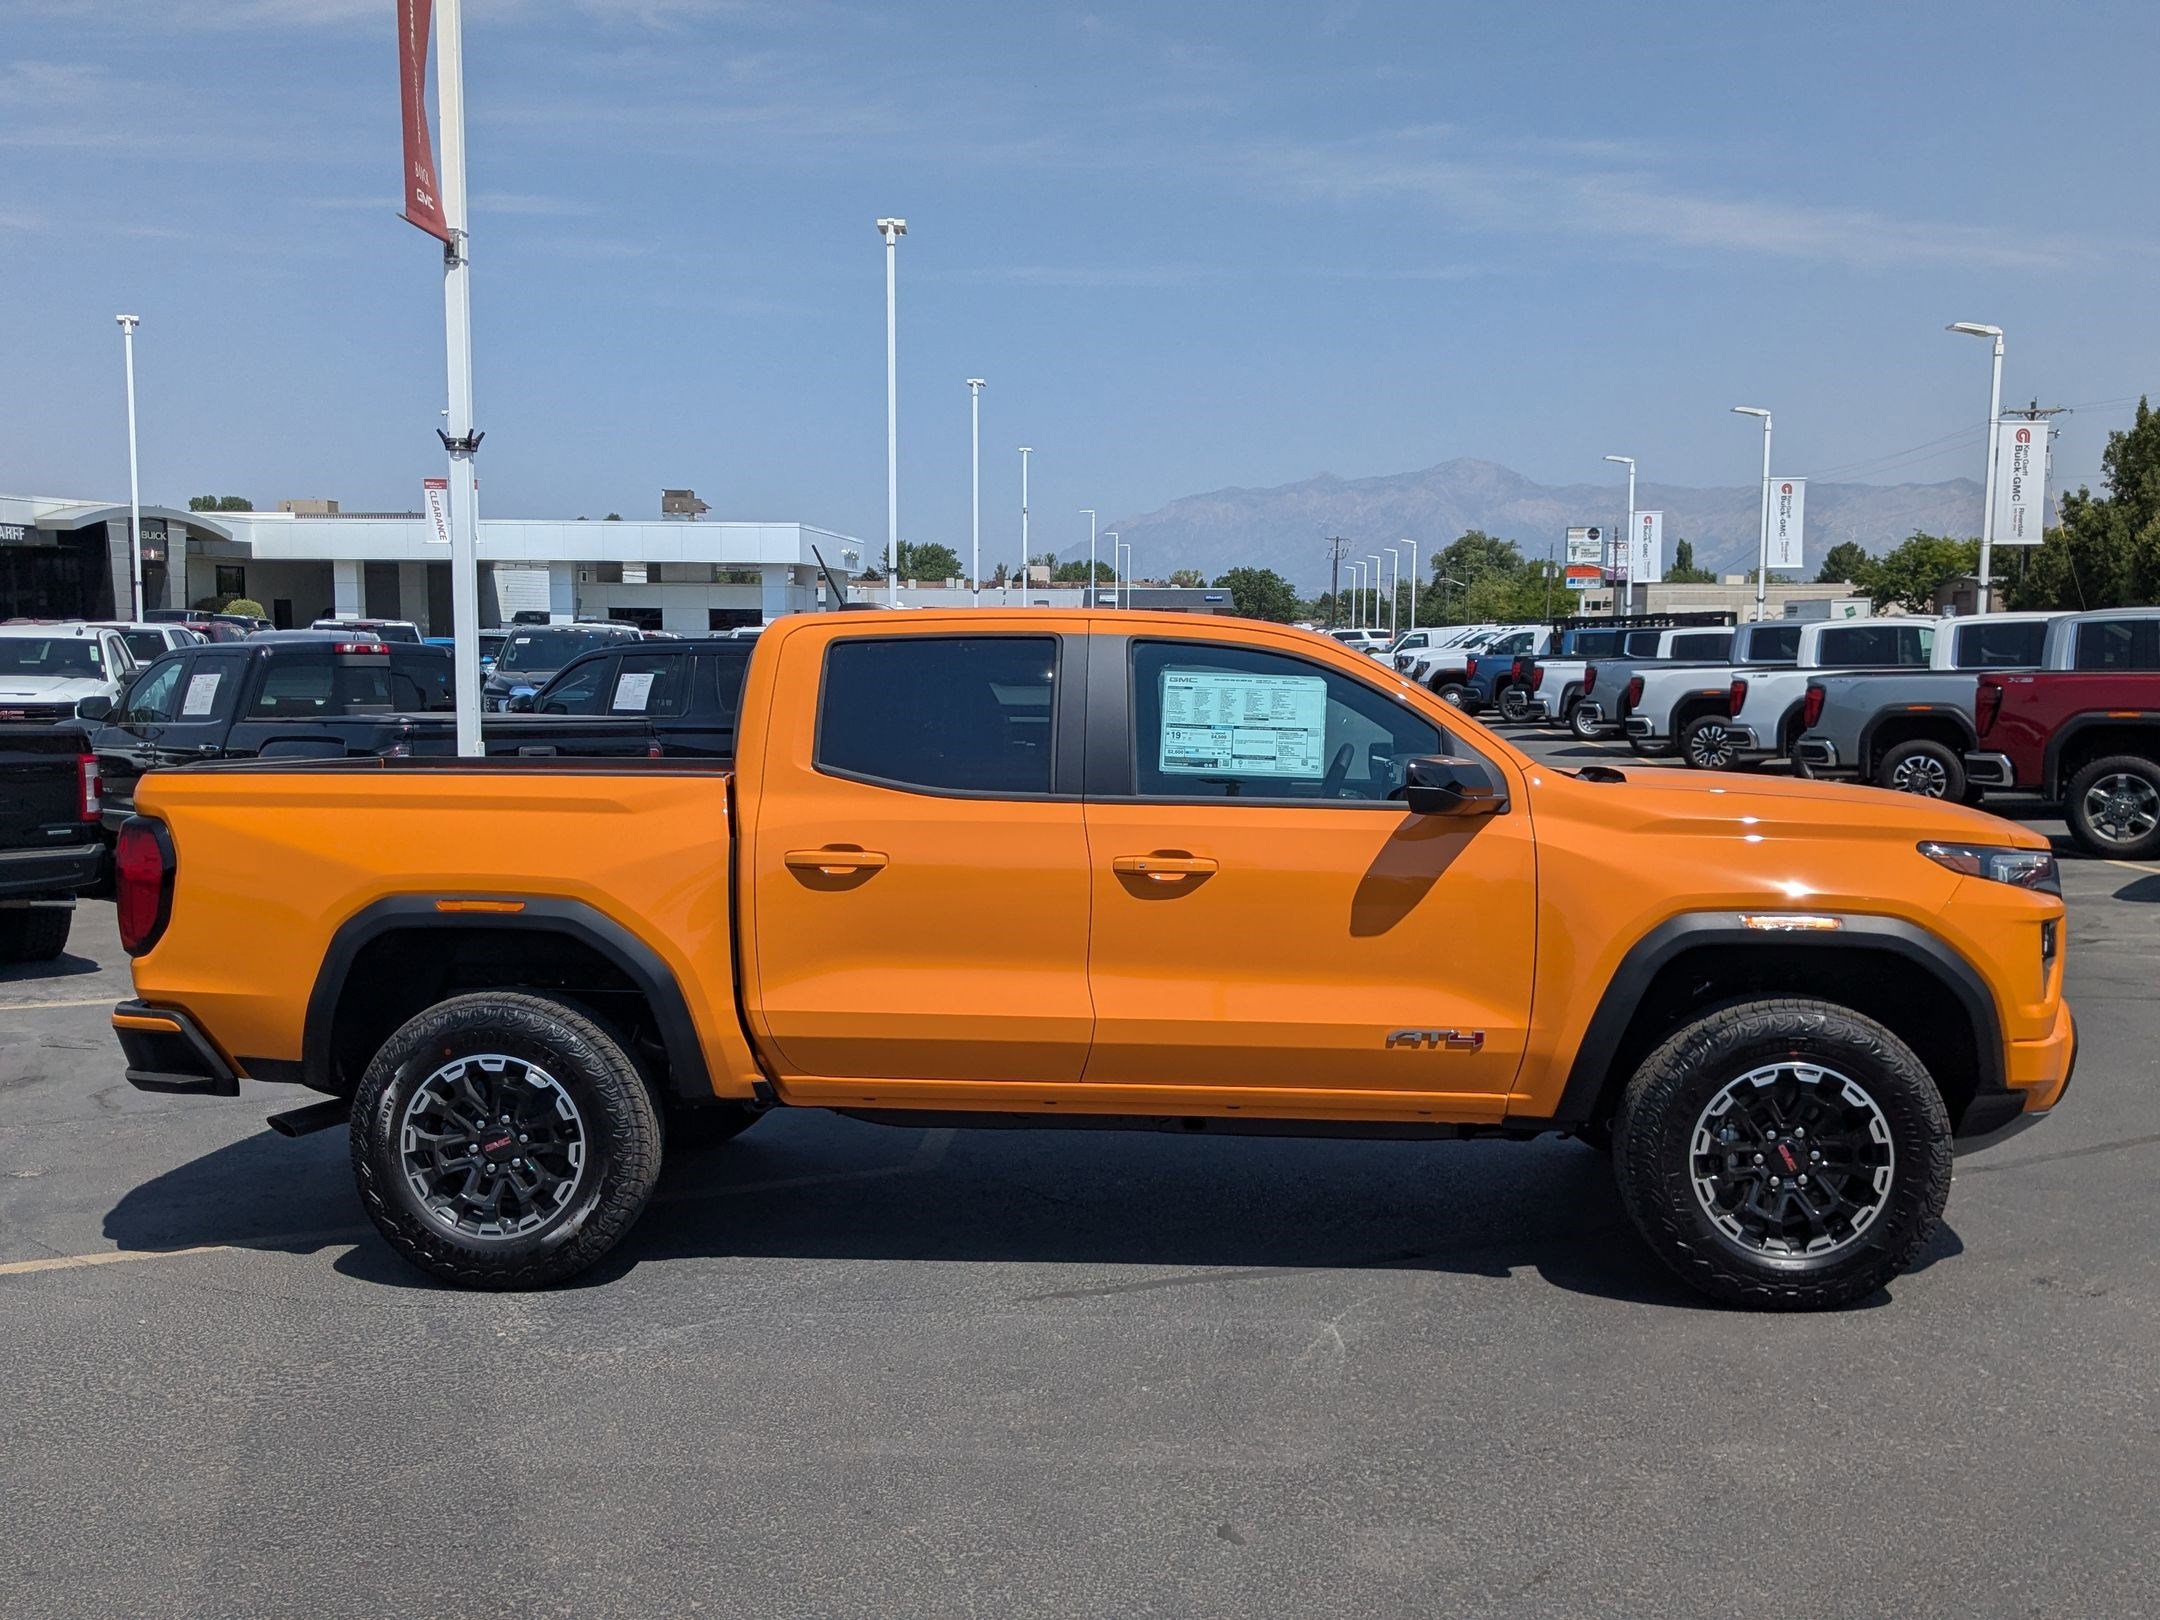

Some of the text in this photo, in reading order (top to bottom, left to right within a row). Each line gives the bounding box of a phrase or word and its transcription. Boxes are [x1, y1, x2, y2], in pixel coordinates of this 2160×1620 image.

[416, 188, 434, 210] GMC
[430, 491, 447, 540] CLEARANCE
[141, 530, 167, 540] BUICK
[1171, 731, 1181, 740] 19
[1386, 1030, 1485, 1050] AT4
[484, 1136, 511, 1152] GMC
[1778, 1144, 1797, 1171] GMC
